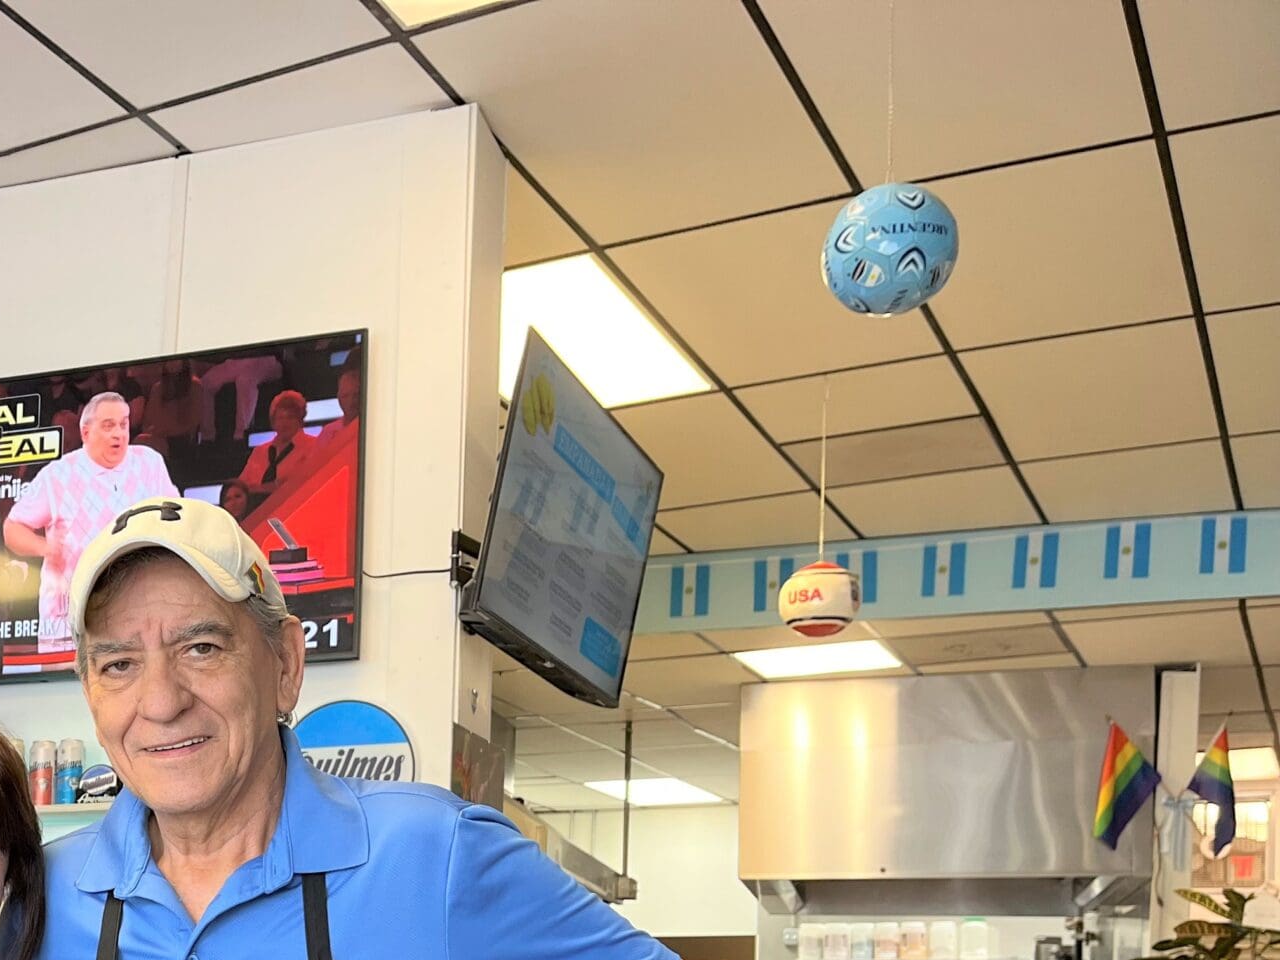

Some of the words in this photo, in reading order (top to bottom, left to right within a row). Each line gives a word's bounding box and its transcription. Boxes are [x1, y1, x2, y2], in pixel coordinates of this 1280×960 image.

[788, 586, 824, 605] USA
[14, 619, 54, 637] BREAK
[302, 618, 339, 649] 21
